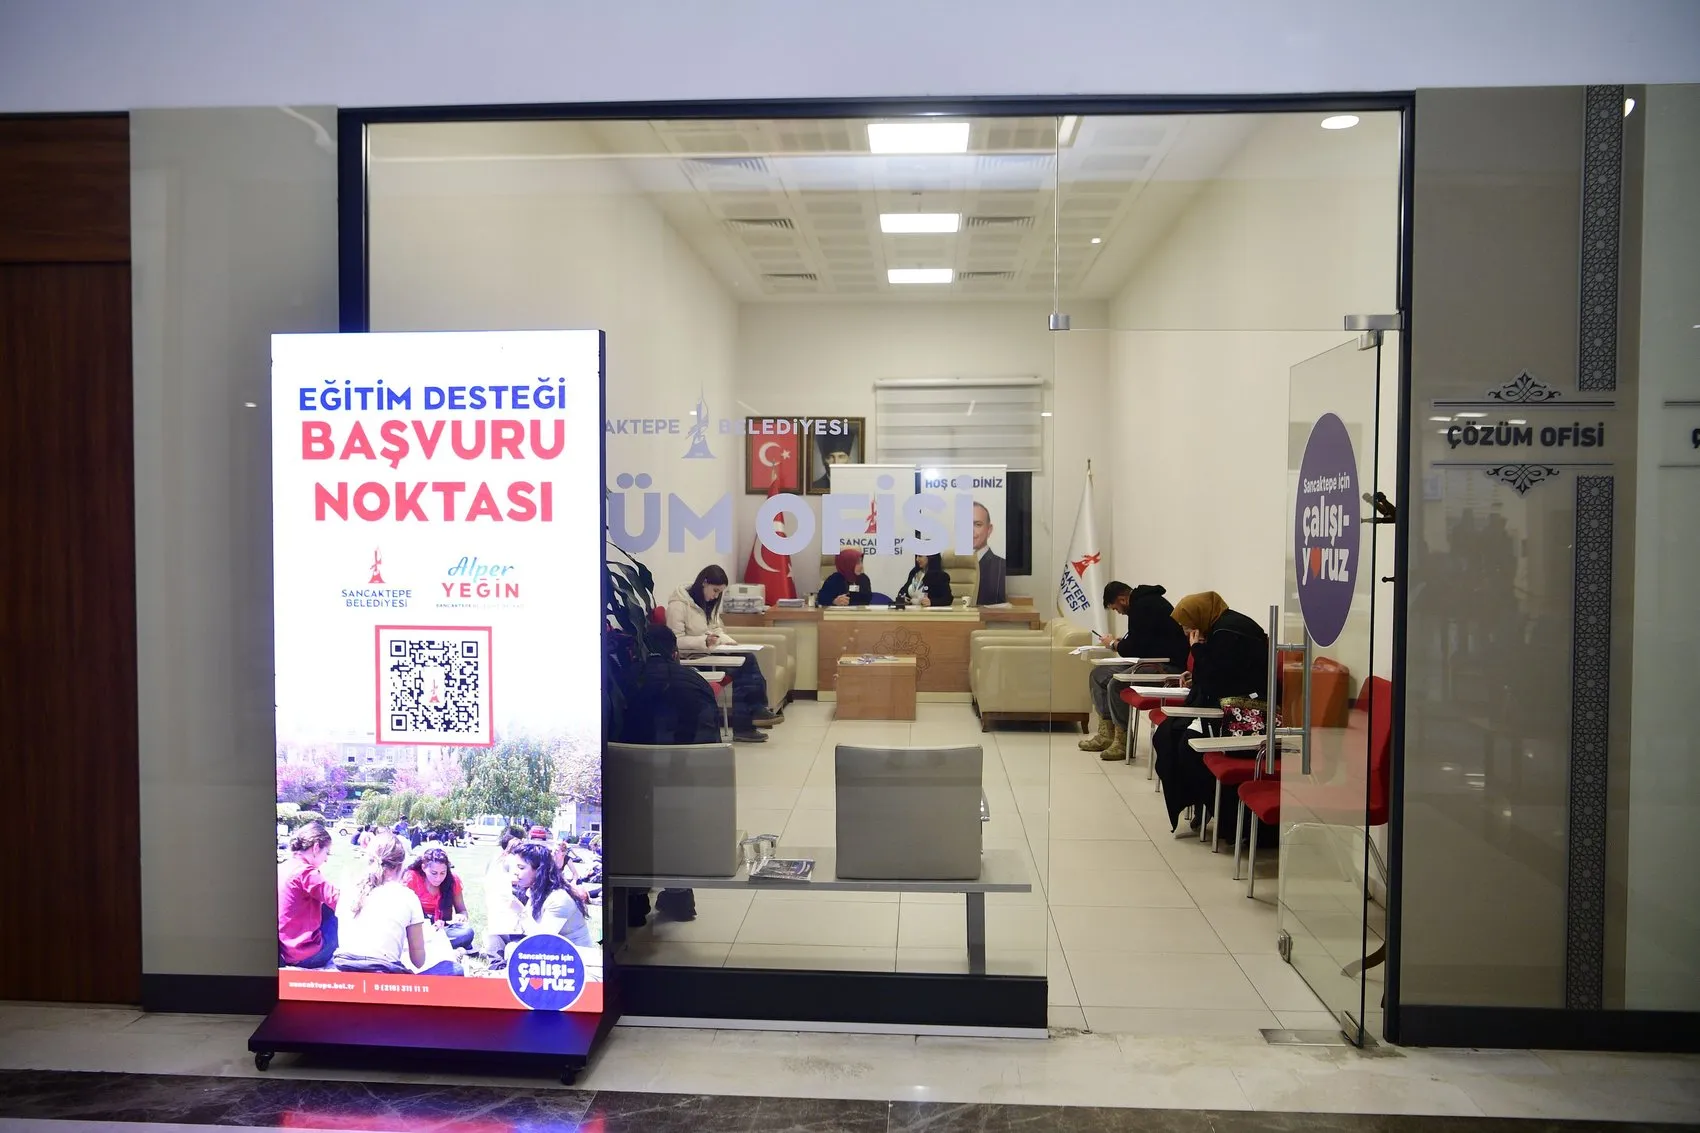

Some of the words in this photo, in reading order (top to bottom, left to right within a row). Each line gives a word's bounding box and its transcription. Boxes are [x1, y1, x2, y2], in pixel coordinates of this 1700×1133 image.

[299, 379, 412, 411] EĞİTİM
[424, 377, 566, 410] DESTEĞİ
[606, 419, 680, 434] AKTEPE
[719, 418, 848, 435] BELEDİYESİ
[1447, 421, 1532, 449] ÇÖZÜM
[1540, 422, 1605, 447] OFİSİ
[301, 419, 565, 470] BAŞVURU
[925, 478, 948, 490] HOŞ
[951, 476, 1003, 489] GDİNİZ
[1303, 475, 1337, 494] Sancaktepe
[1338, 472, 1350, 492] için
[315, 481, 553, 522] NOKTASI
[608, 473, 732, 554] ÜM
[756, 474, 974, 556] OFİSİ
[447, 556, 515, 583] Alper
[341, 589, 412, 599] SANCAKTEPE
[441, 578, 520, 599] YEĞİN
[1064, 563, 1091, 611] AKTEPE
[345, 598, 408, 609] BELEDİYESİ
